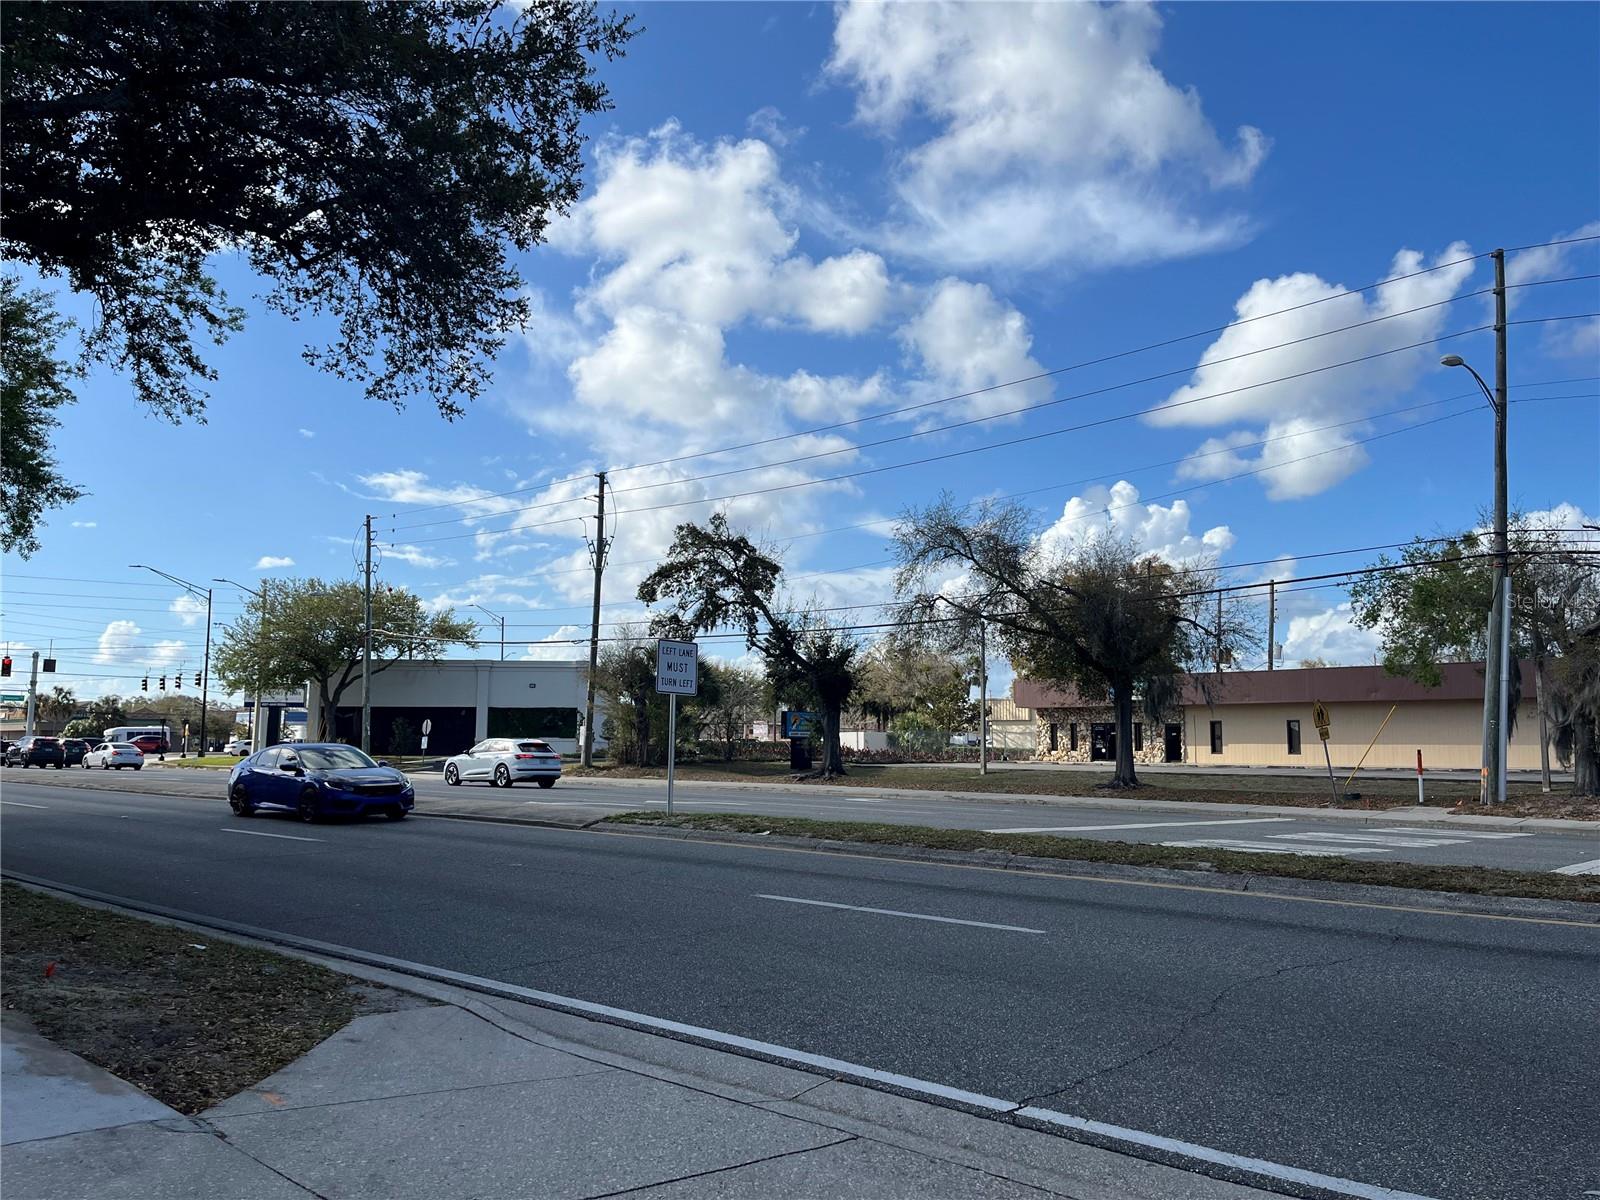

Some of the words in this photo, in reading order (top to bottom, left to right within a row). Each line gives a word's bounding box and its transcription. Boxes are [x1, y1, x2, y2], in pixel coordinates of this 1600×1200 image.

[662, 647, 676, 655] LEFT
[679, 648, 694, 658] LANE
[667, 662, 688, 673] MUST
[661, 677, 677, 687] TURN
[679, 680, 693, 688] LEFT
